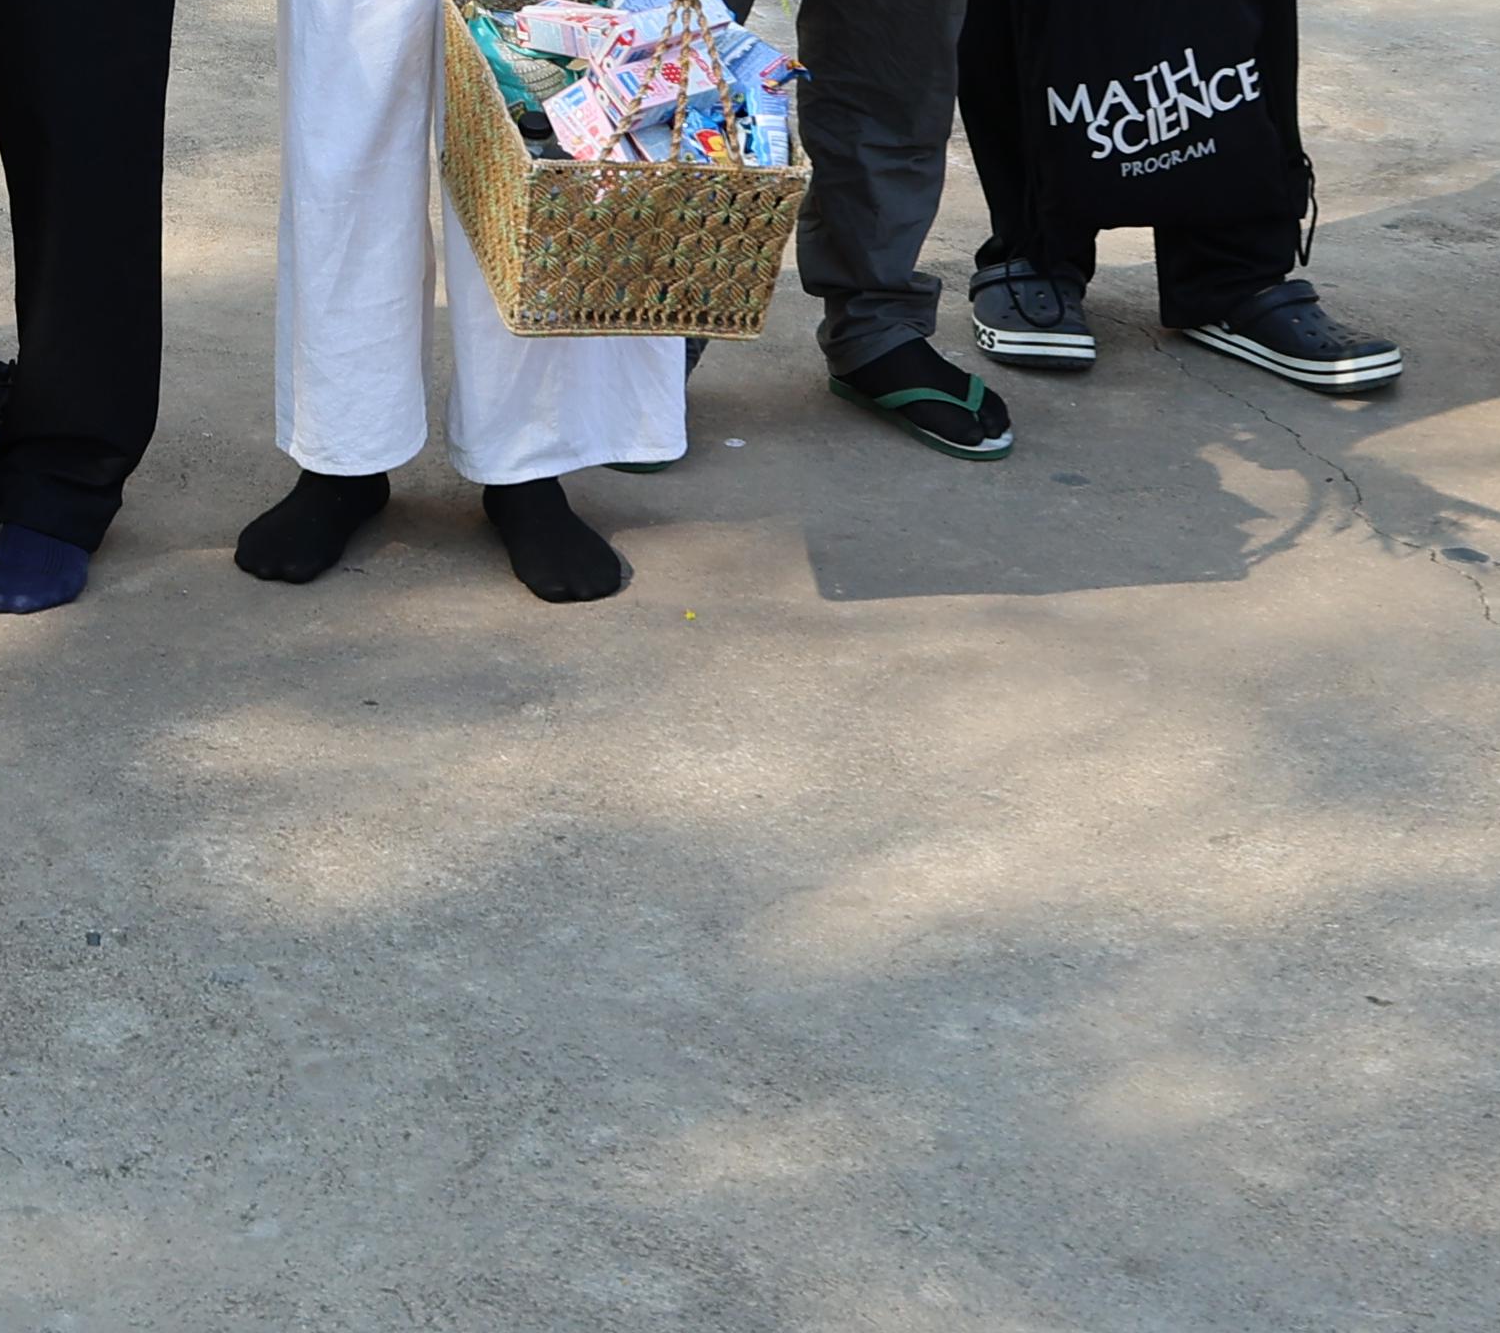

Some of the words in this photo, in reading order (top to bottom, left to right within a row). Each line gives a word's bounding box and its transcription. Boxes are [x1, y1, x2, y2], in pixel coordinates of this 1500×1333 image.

[1047, 47, 1200, 126] MATH
[1086, 58, 1261, 159] SCIENCE
[1121, 138, 1216, 177] PROGRAM
